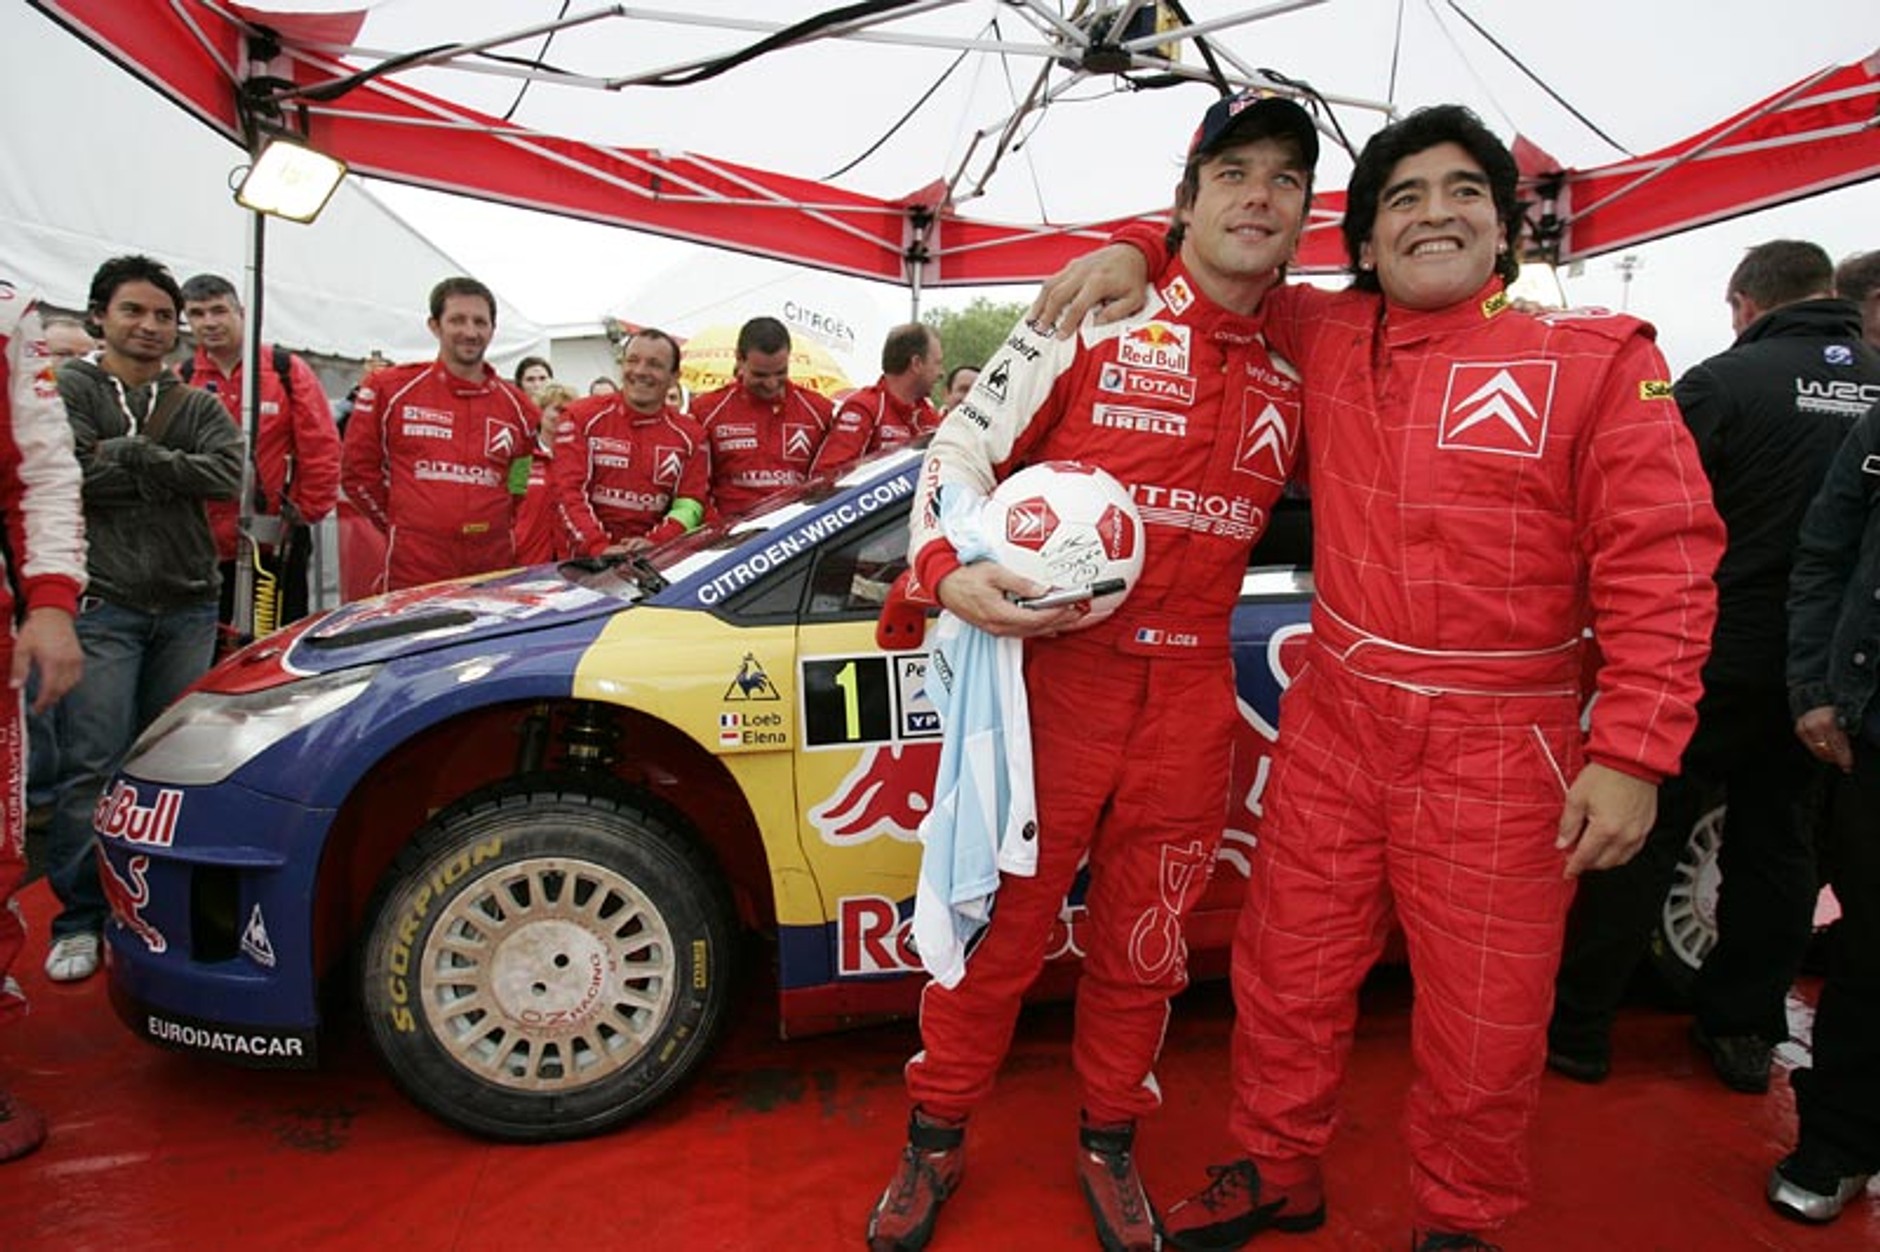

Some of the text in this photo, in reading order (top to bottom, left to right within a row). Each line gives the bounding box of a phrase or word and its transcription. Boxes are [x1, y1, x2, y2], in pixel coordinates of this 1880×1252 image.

[1121, 345, 1186, 371] Red Bull
[1128, 374, 1191, 399] TOTAL
[1093, 402, 1186, 437] PIRELLI
[1128, 484, 1264, 526] ITROËN
[698, 476, 912, 604] CITROEN-WRC.COM
[742, 713, 782, 727] Loeb
[836, 662, 861, 740] 1
[742, 730, 787, 744] Elena
[388, 836, 504, 1032] SCORPION
[148, 1015, 303, 1057] EURODATACAR
